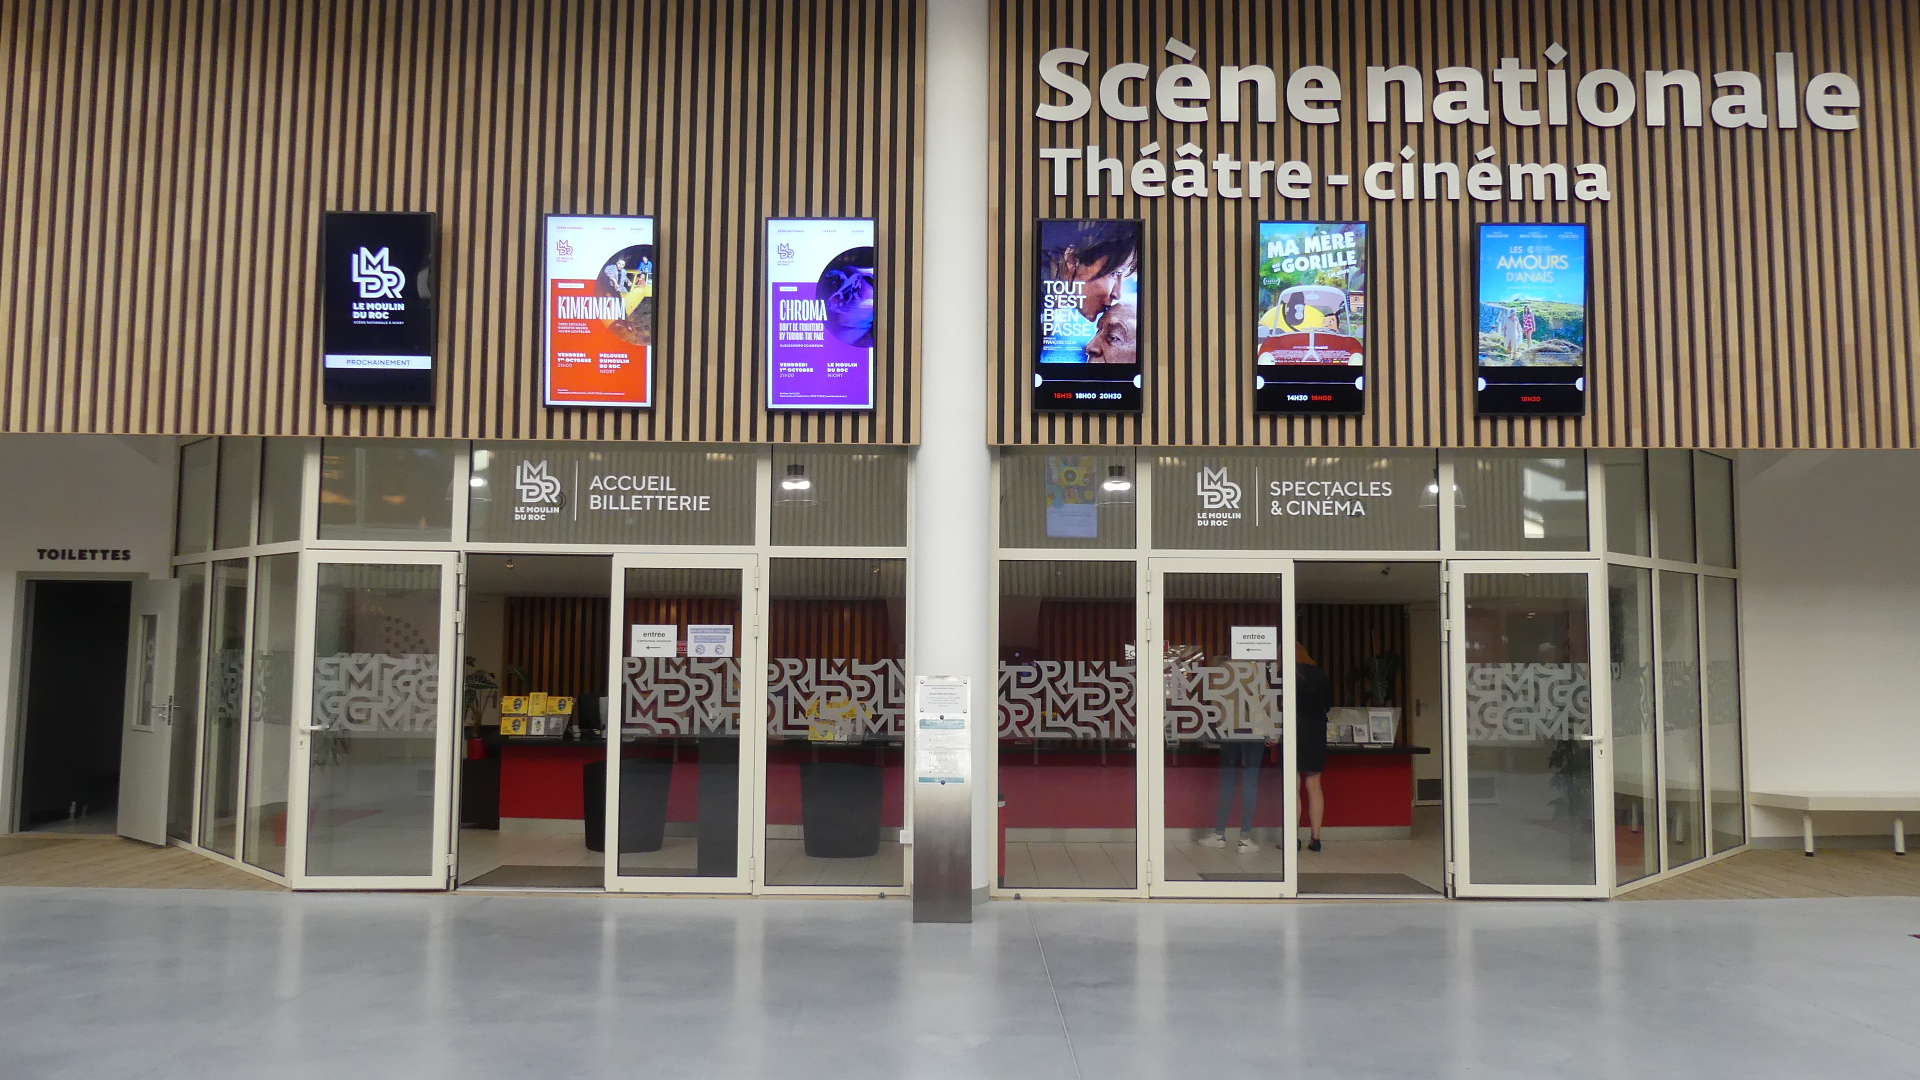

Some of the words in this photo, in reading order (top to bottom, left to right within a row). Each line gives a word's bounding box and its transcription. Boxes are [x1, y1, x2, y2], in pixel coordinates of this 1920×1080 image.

[1035, 37, 1342, 124] Scène
[1366, 41, 1861, 131] nationale
[1040, 142, 1313, 199] Théâtre
[1363, 145, 1612, 201] cinéma
[1267, 239, 1300, 259] MA
[1304, 230, 1356, 254] MÈRE
[1509, 246, 1523, 254] LES
[1281, 249, 1357, 274] GORILLE
[1496, 255, 1569, 270] AMOURS
[1043, 281, 1086, 295] TOUT
[352, 302, 366, 310] LE
[366, 302, 405, 311] MOULIN
[558, 295, 626, 321] KIMKIMKIM
[1043, 294, 1087, 309] S'EST
[352, 311, 367, 319] DU
[368, 311, 390, 320] ROC
[779, 299, 828, 321] CHROMA
[1043, 308, 1079, 323] BIEN
[589, 475, 676, 491] ACCUEIL
[1269, 481, 1393, 497] SPECTACLES
[514, 506, 526, 514] LE
[526, 506, 560, 514] MOULIN
[589, 494, 711, 511] BILLETTERIE
[1270, 500, 1283, 516] &
[1286, 496, 1366, 516] CINÉMA
[1210, 519, 1228, 527] ROC
[37, 548, 132, 561] TOILETTES
